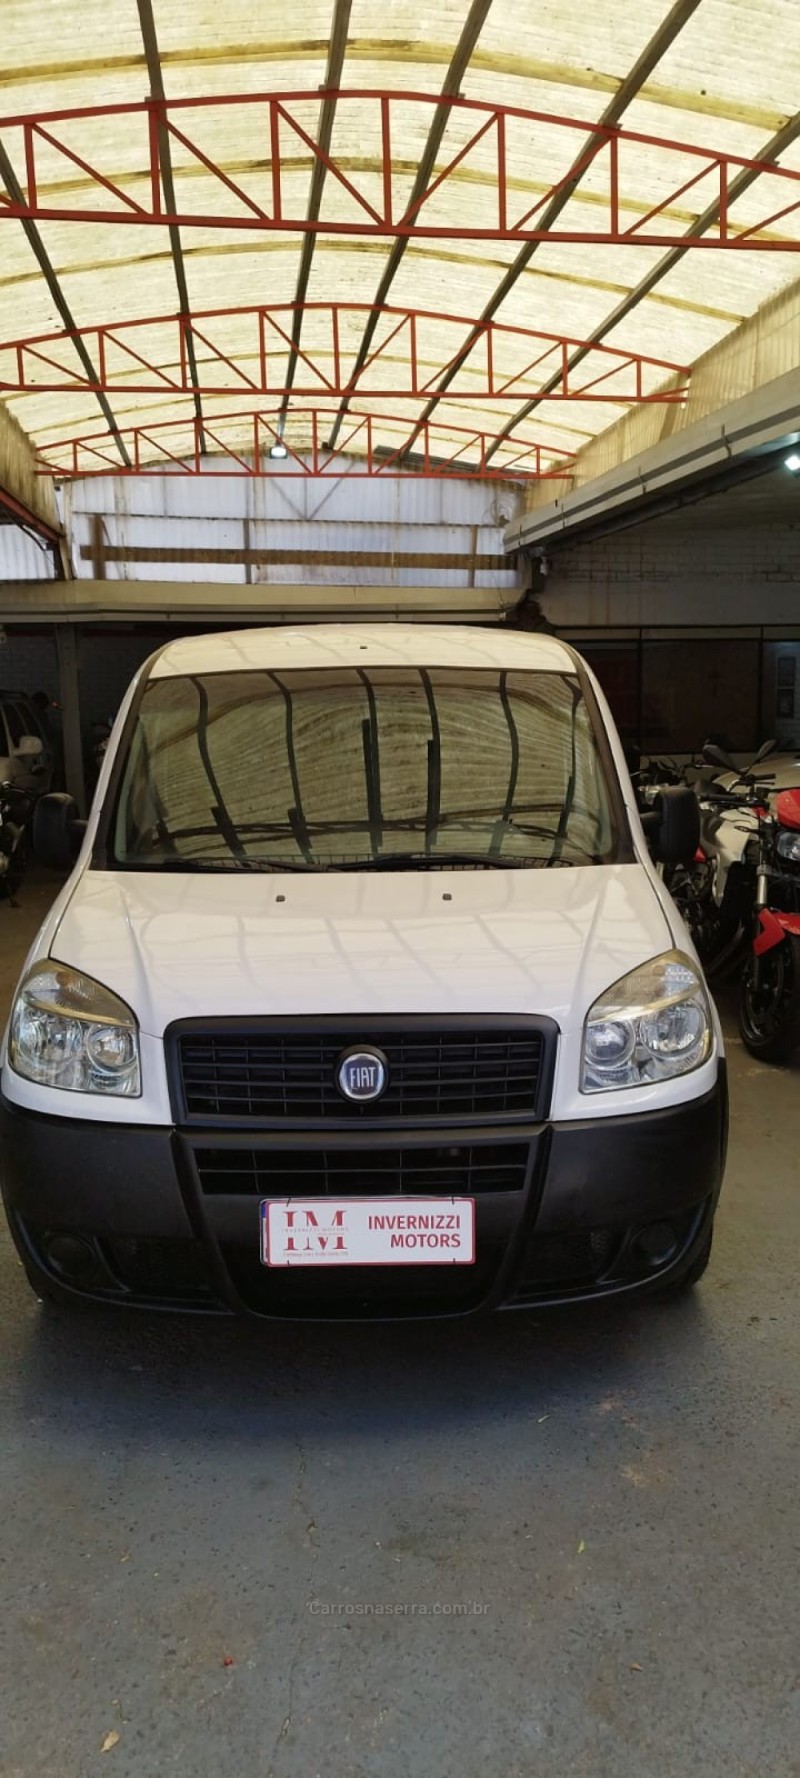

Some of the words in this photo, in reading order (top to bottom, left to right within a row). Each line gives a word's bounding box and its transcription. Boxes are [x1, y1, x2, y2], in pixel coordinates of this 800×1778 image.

[349, 1066, 376, 1087] FIAT
[368, 1215, 461, 1230] INVERNIZZI
[390, 1233, 461, 1248] MOTORS
